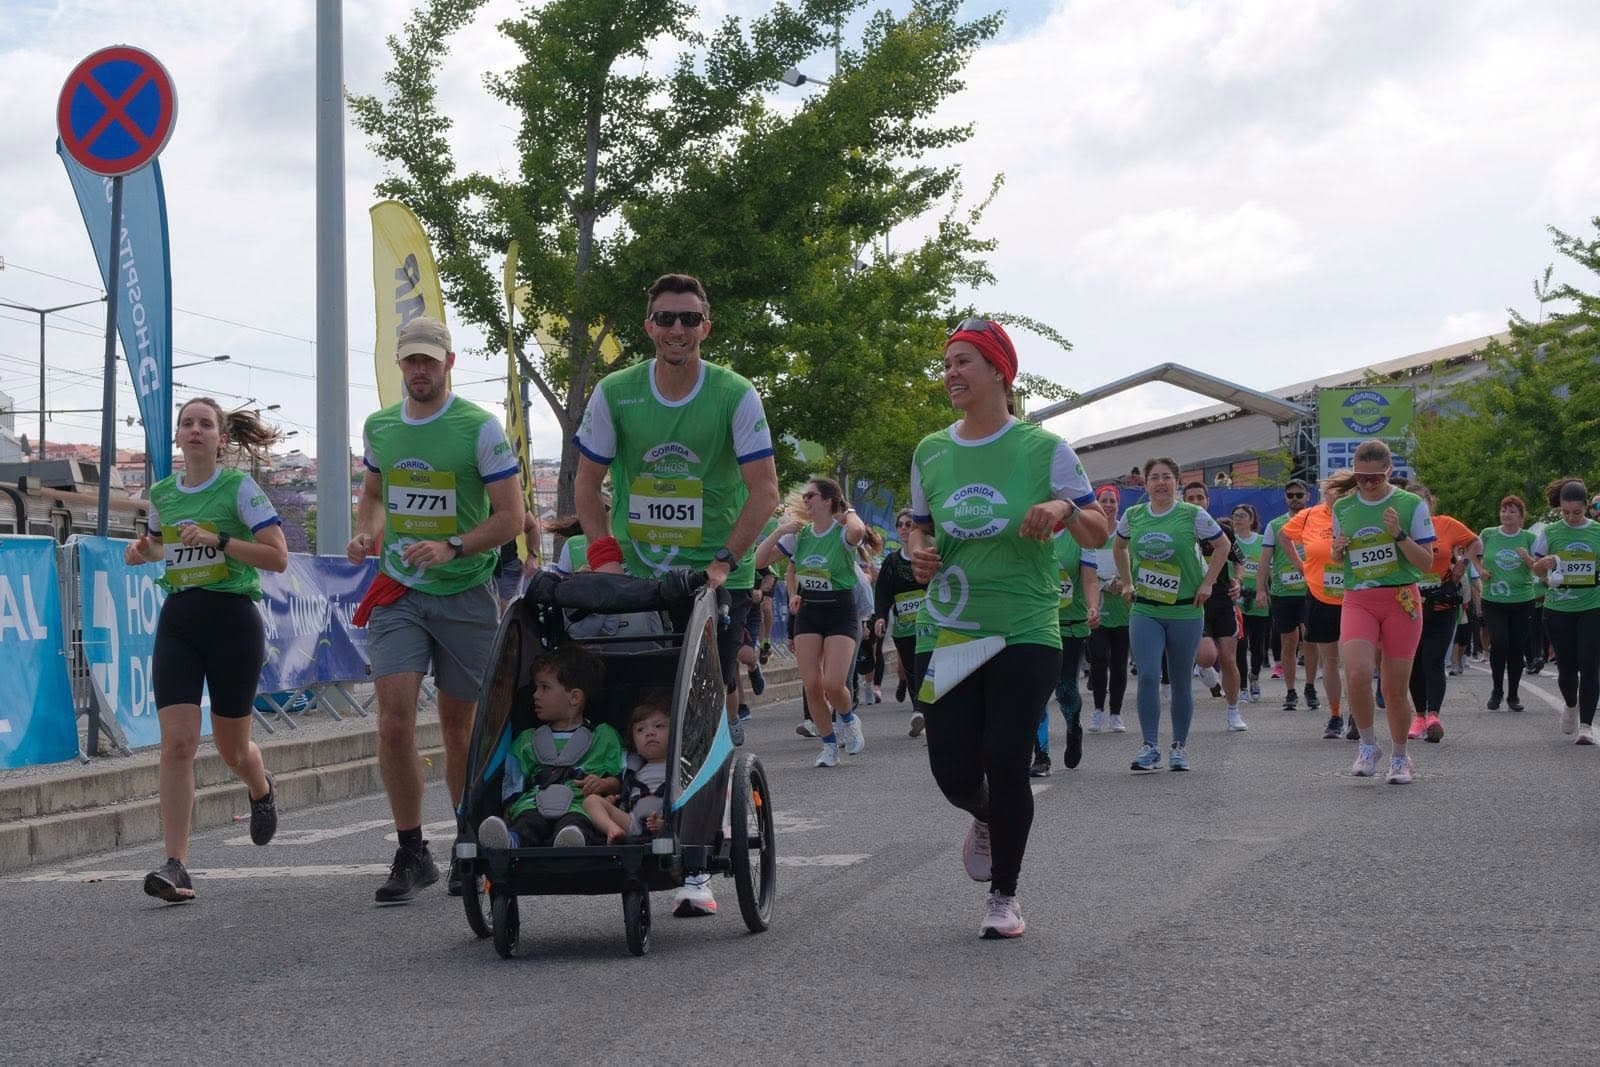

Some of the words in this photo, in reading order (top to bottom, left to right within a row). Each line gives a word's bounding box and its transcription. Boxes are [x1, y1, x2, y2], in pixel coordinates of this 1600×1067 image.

[651, 445, 689, 458] CORRIDA
[406, 493, 447, 511] 7771
[953, 486, 995, 502] CORRIDA
[647, 503, 695, 521] 11051
[954, 502, 994, 518] MIMOSA
[952, 527, 975, 539] PELA
[975, 525, 999, 537] VIDA
[174, 545, 217, 564] 7770
[1361, 547, 1393, 563] 5205
[1567, 562, 1592, 572] 8975
[805, 579, 828, 589] 5124
[1145, 573, 1178, 590] 12462
[902, 601, 921, 611] 299
